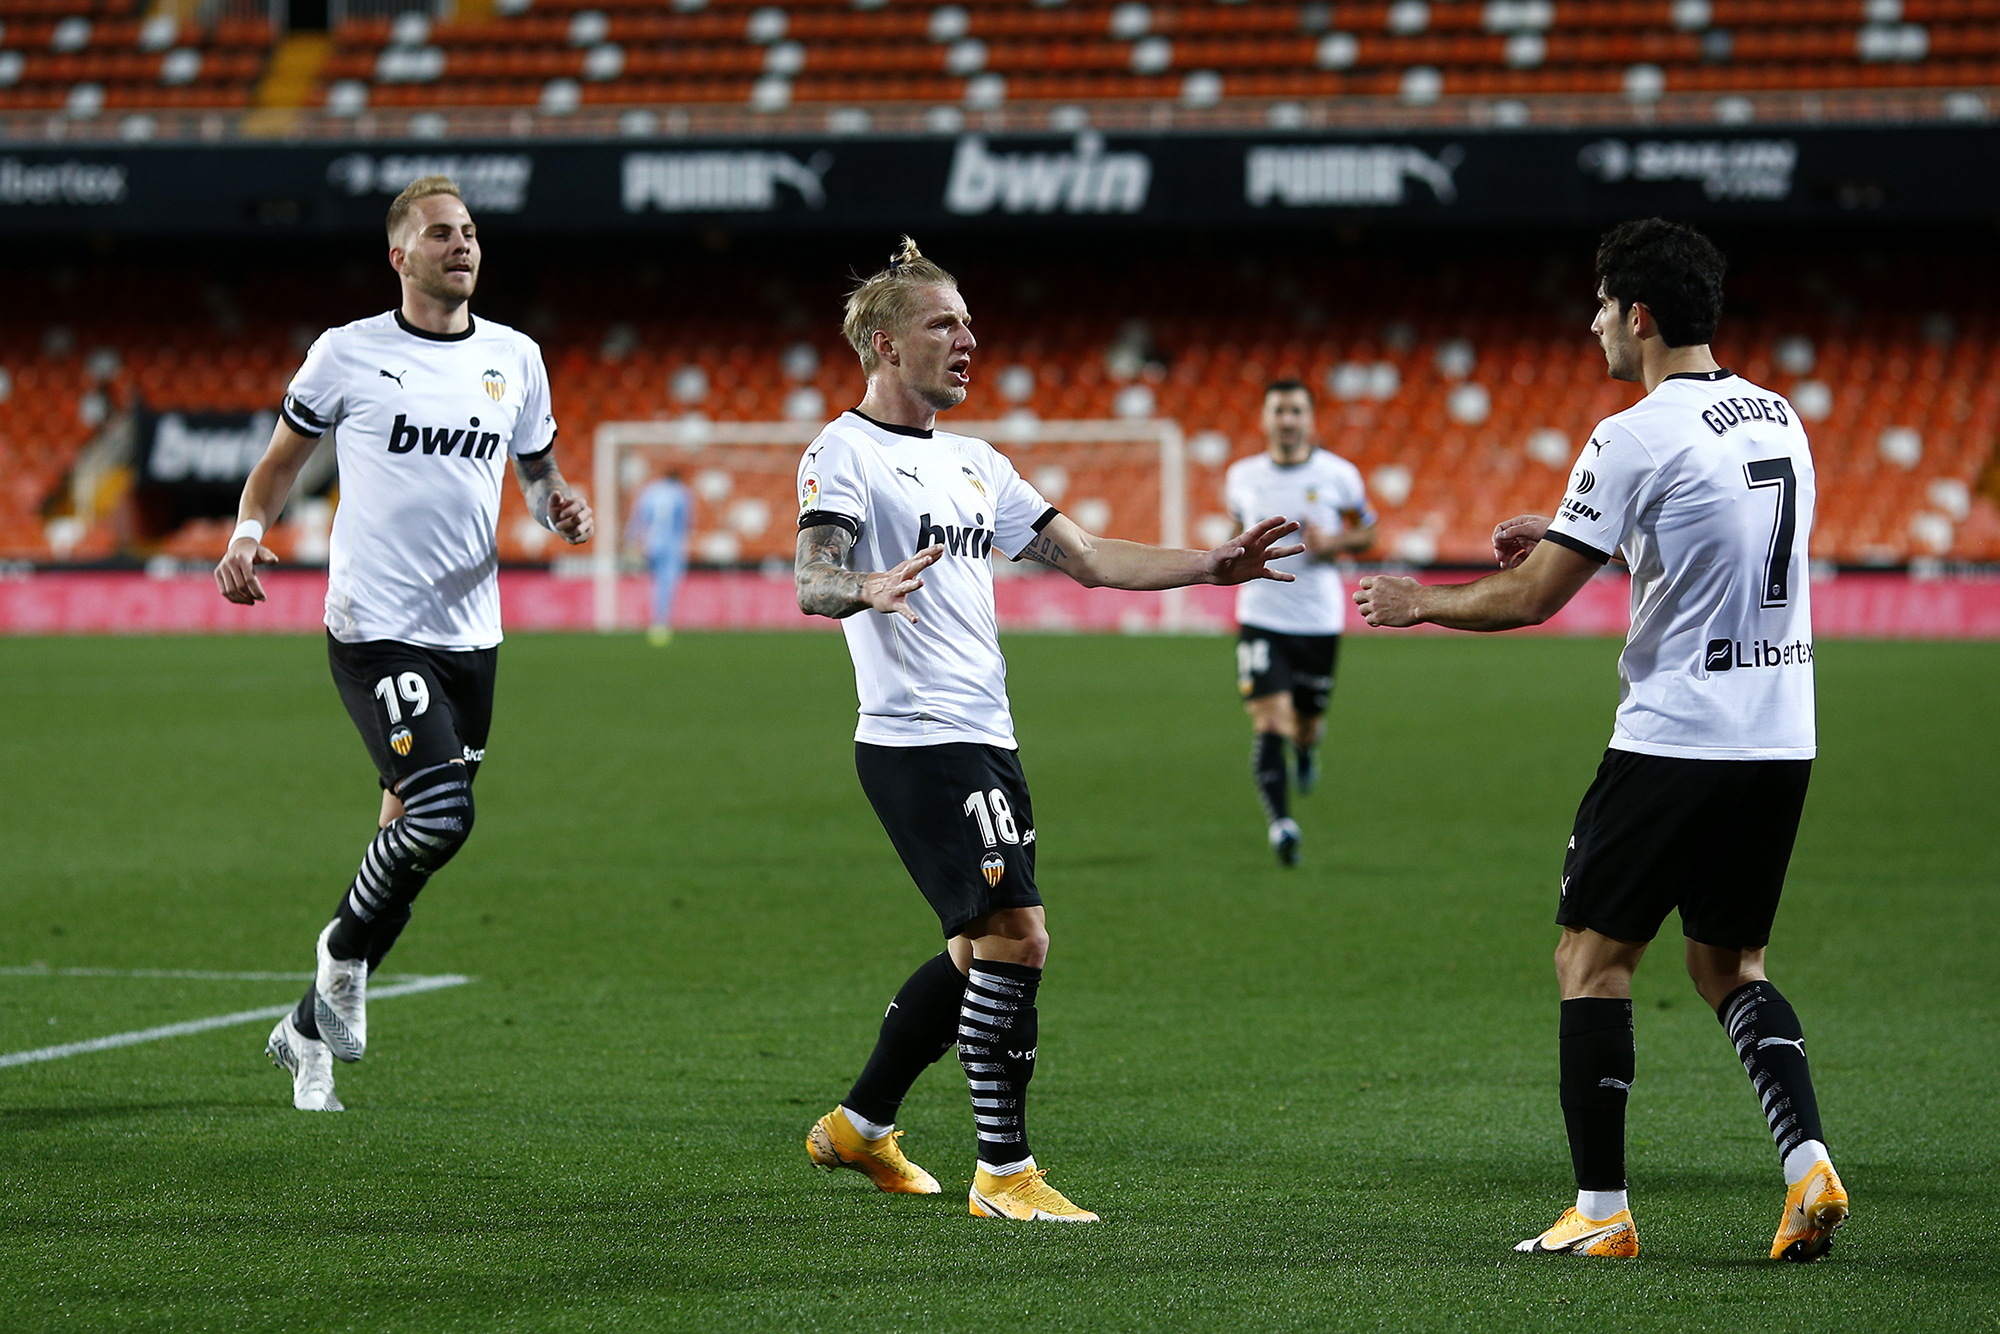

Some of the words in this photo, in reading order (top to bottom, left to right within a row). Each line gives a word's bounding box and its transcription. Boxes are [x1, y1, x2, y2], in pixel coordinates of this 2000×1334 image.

[621, 152, 775, 213] PUMA
[945, 129, 1152, 214] bwin
[1245, 147, 1405, 207] PUMA
[152, 412, 276, 482] bwi
[387, 414, 501, 460] bwin
[1701, 397, 1789, 437] GUEDES
[1743, 456, 1797, 609] 7
[374, 671, 430, 725] 19
[963, 788, 1020, 848] 18
